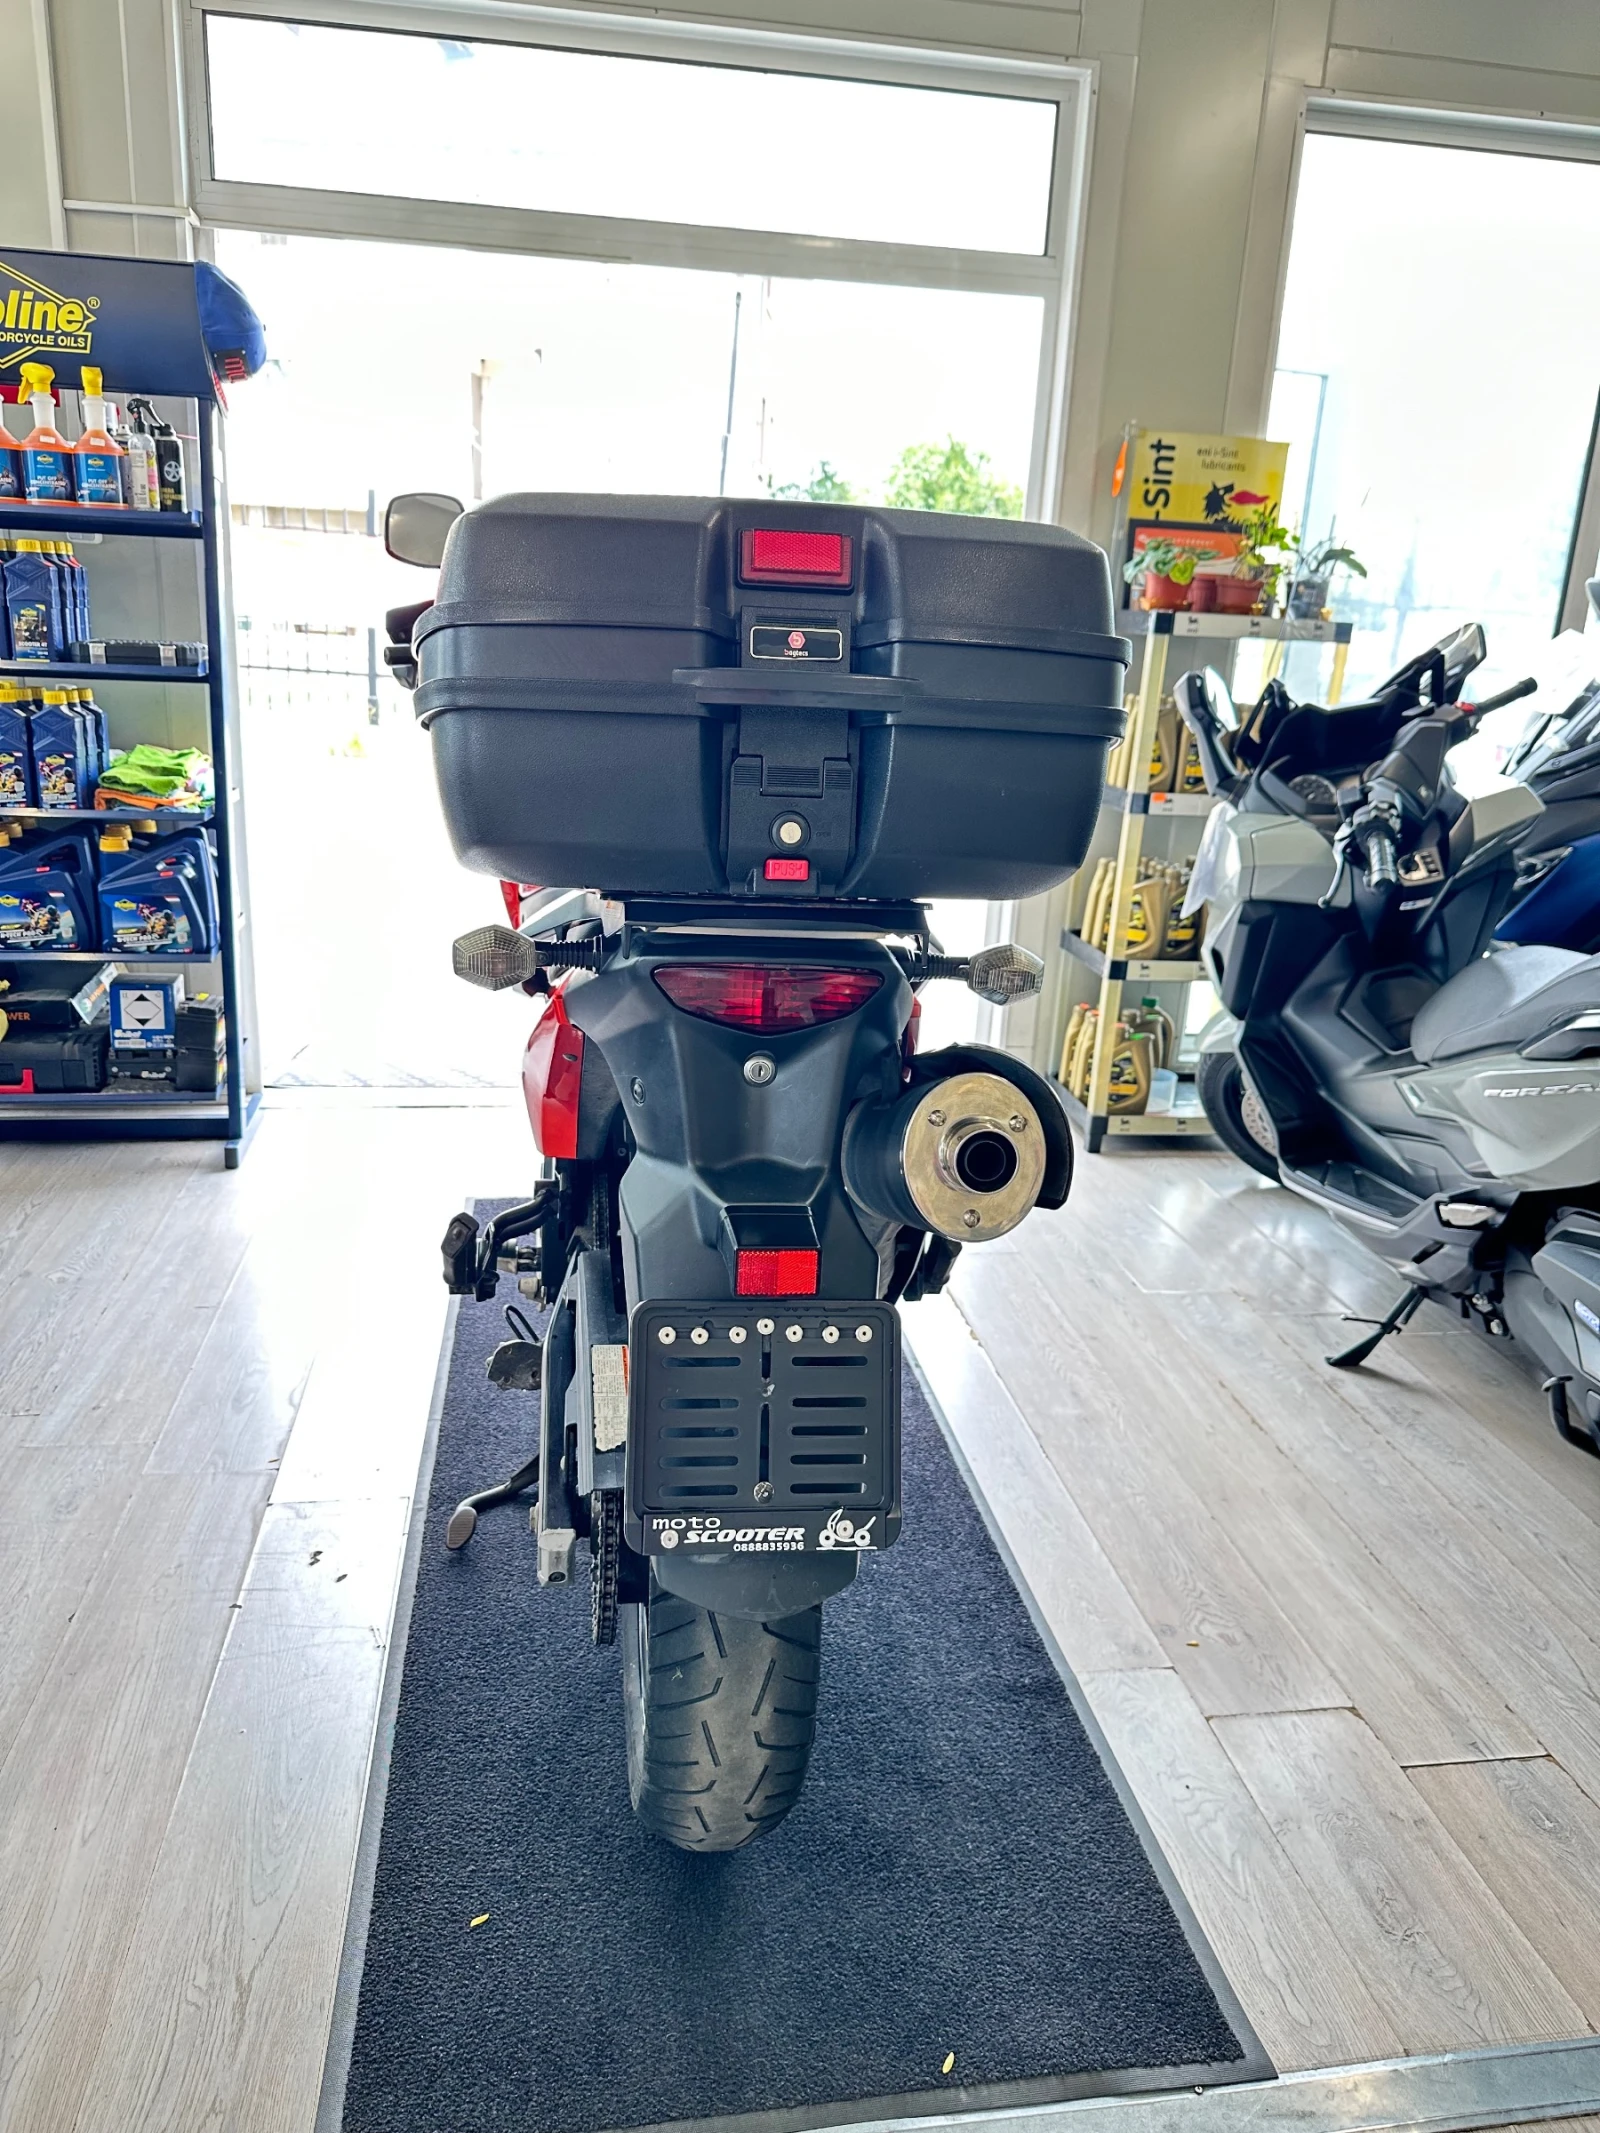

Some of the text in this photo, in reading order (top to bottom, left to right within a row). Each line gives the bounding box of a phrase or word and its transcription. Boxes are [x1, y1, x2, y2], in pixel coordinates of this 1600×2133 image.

[0, 290, 84, 332] line
[57, 335, 86, 348] OILS
[773, 862, 803, 877] PUSH
[652, 1516, 721, 1530] moto
[683, 1527, 806, 1544] SCOOTER
[732, 1541, 805, 1552] 0888835936
